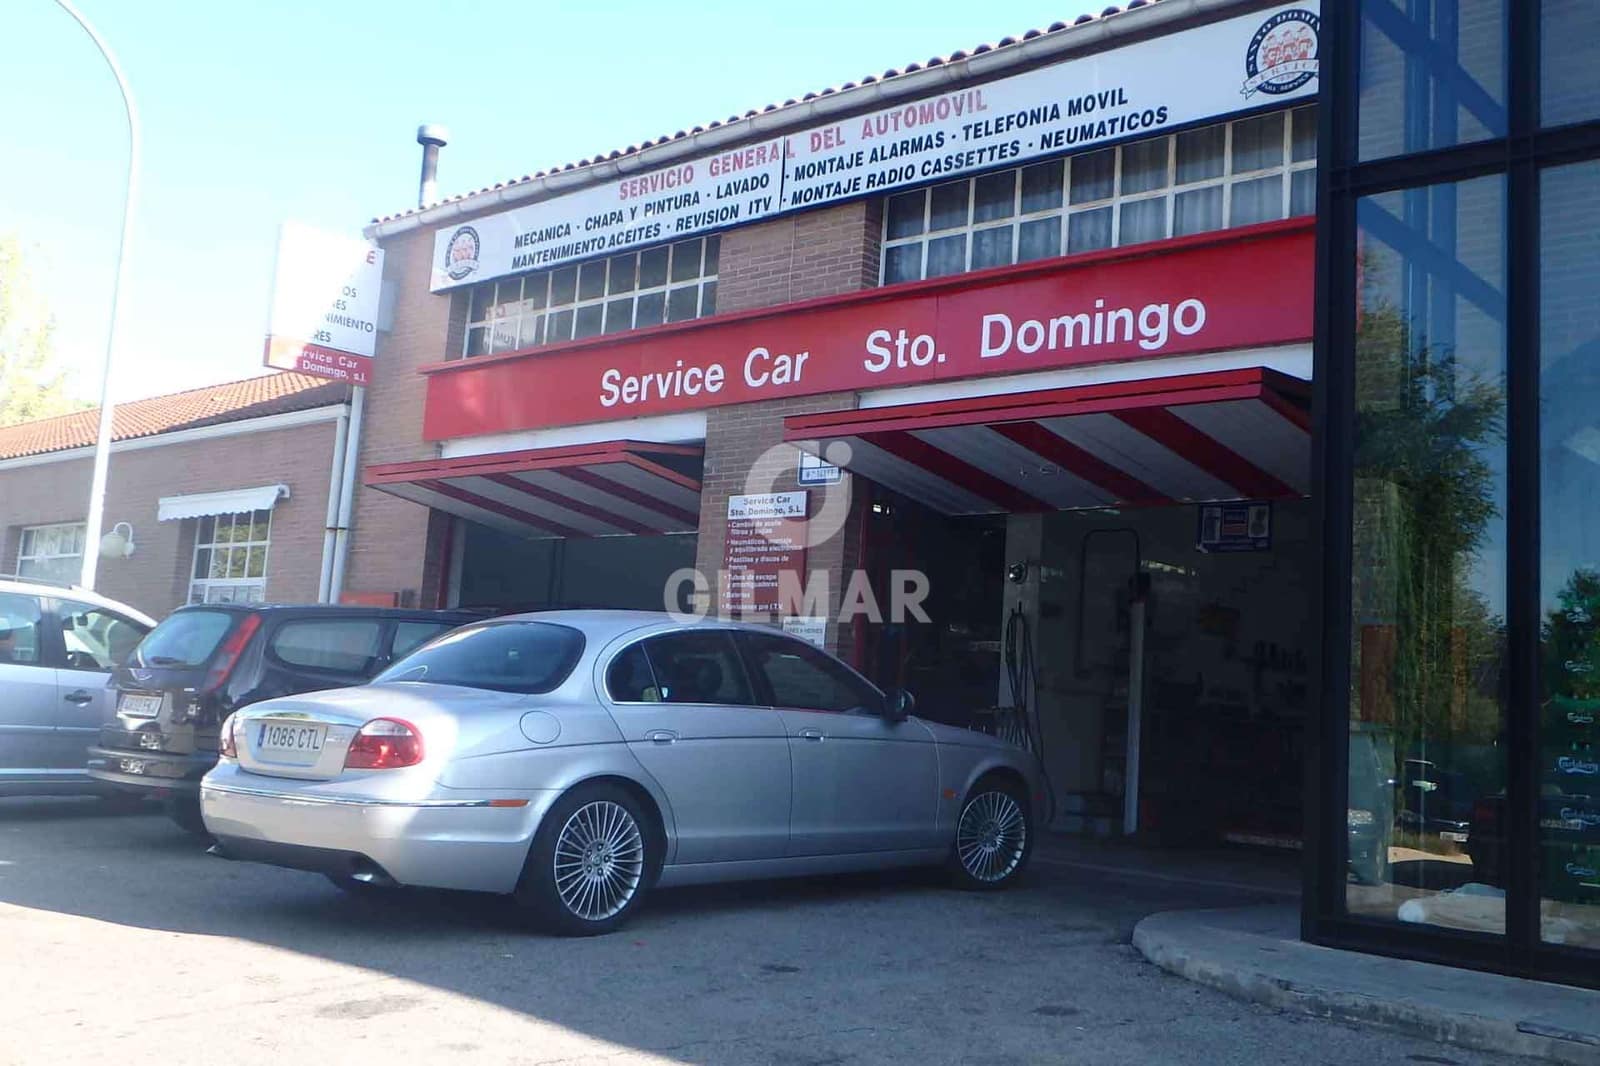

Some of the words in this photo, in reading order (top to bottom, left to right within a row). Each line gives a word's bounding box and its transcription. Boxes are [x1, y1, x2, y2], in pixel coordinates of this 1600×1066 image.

[511, 237, 606, 270] MANTENIMIENTO
[608, 223, 661, 248] ACEITES
[676, 205, 740, 232] REVISION
[749, 195, 772, 215] ITV
[791, 176, 862, 206] MONTAJE
[866, 164, 916, 189] RADIO
[920, 139, 1021, 177] CASSETTES
[1039, 105, 1168, 150] NEUMATICOS
[514, 223, 571, 249] MECANICA
[585, 209, 624, 231] CHAPA
[629, 206, 638, 220] Y
[644, 190, 700, 217] PINTURA
[716, 173, 770, 199] LAVADO
[794, 151, 864, 182] MONTAJE
[869, 131, 945, 163] ALARMAS
[962, 103, 1061, 141] TELEFONIA
[1067, 87, 1128, 117] MOVIL
[620, 165, 695, 200] SERVICIO
[709, 139, 795, 177] GENERAL
[810, 126, 846, 153] DEL
[861, 90, 987, 140] AUTOMOVIL
[338, 356, 359, 369] Car
[600, 360, 724, 408] Service
[743, 347, 809, 388] Car
[863, 328, 947, 373] Sto.
[980, 298, 1207, 359] Domingo
[743, 497, 775, 505] Service
[776, 496, 791, 504] Car
[267, 726, 296, 748] 1086
[297, 728, 320, 750] CTL
